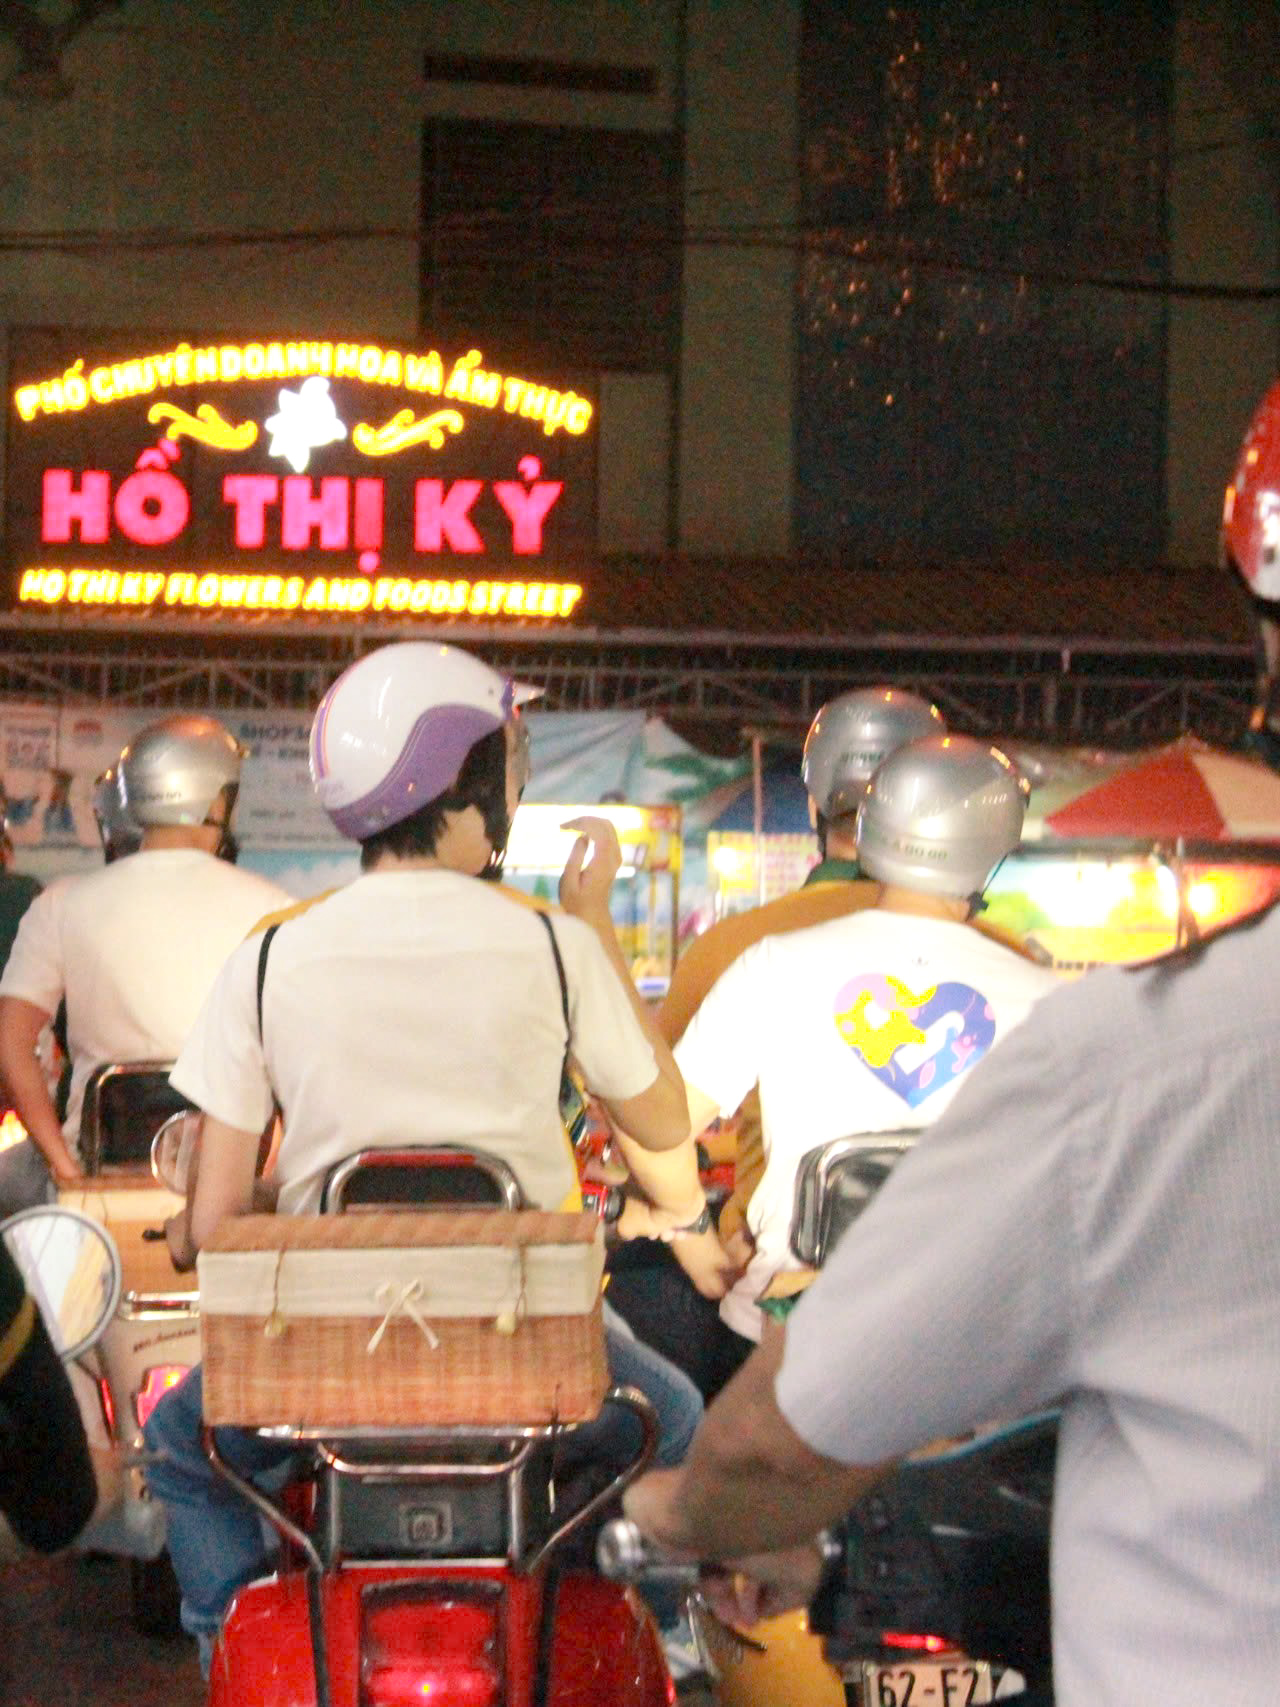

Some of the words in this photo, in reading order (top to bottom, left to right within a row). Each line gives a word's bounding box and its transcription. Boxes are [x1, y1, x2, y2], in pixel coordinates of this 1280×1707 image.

[334, 343, 402, 386] HOA
[42, 437, 189, 546] HỒ
[224, 474, 384, 573] THỊ
[20, 569, 66, 603] HO
[68, 569, 120, 604] THI
[120, 572, 165, 605] KY
[165, 573, 304, 609] FLOWERS
[302, 577, 372, 611] AND
[372, 577, 470, 613] FOODS
[468, 580, 582, 617] STREET
